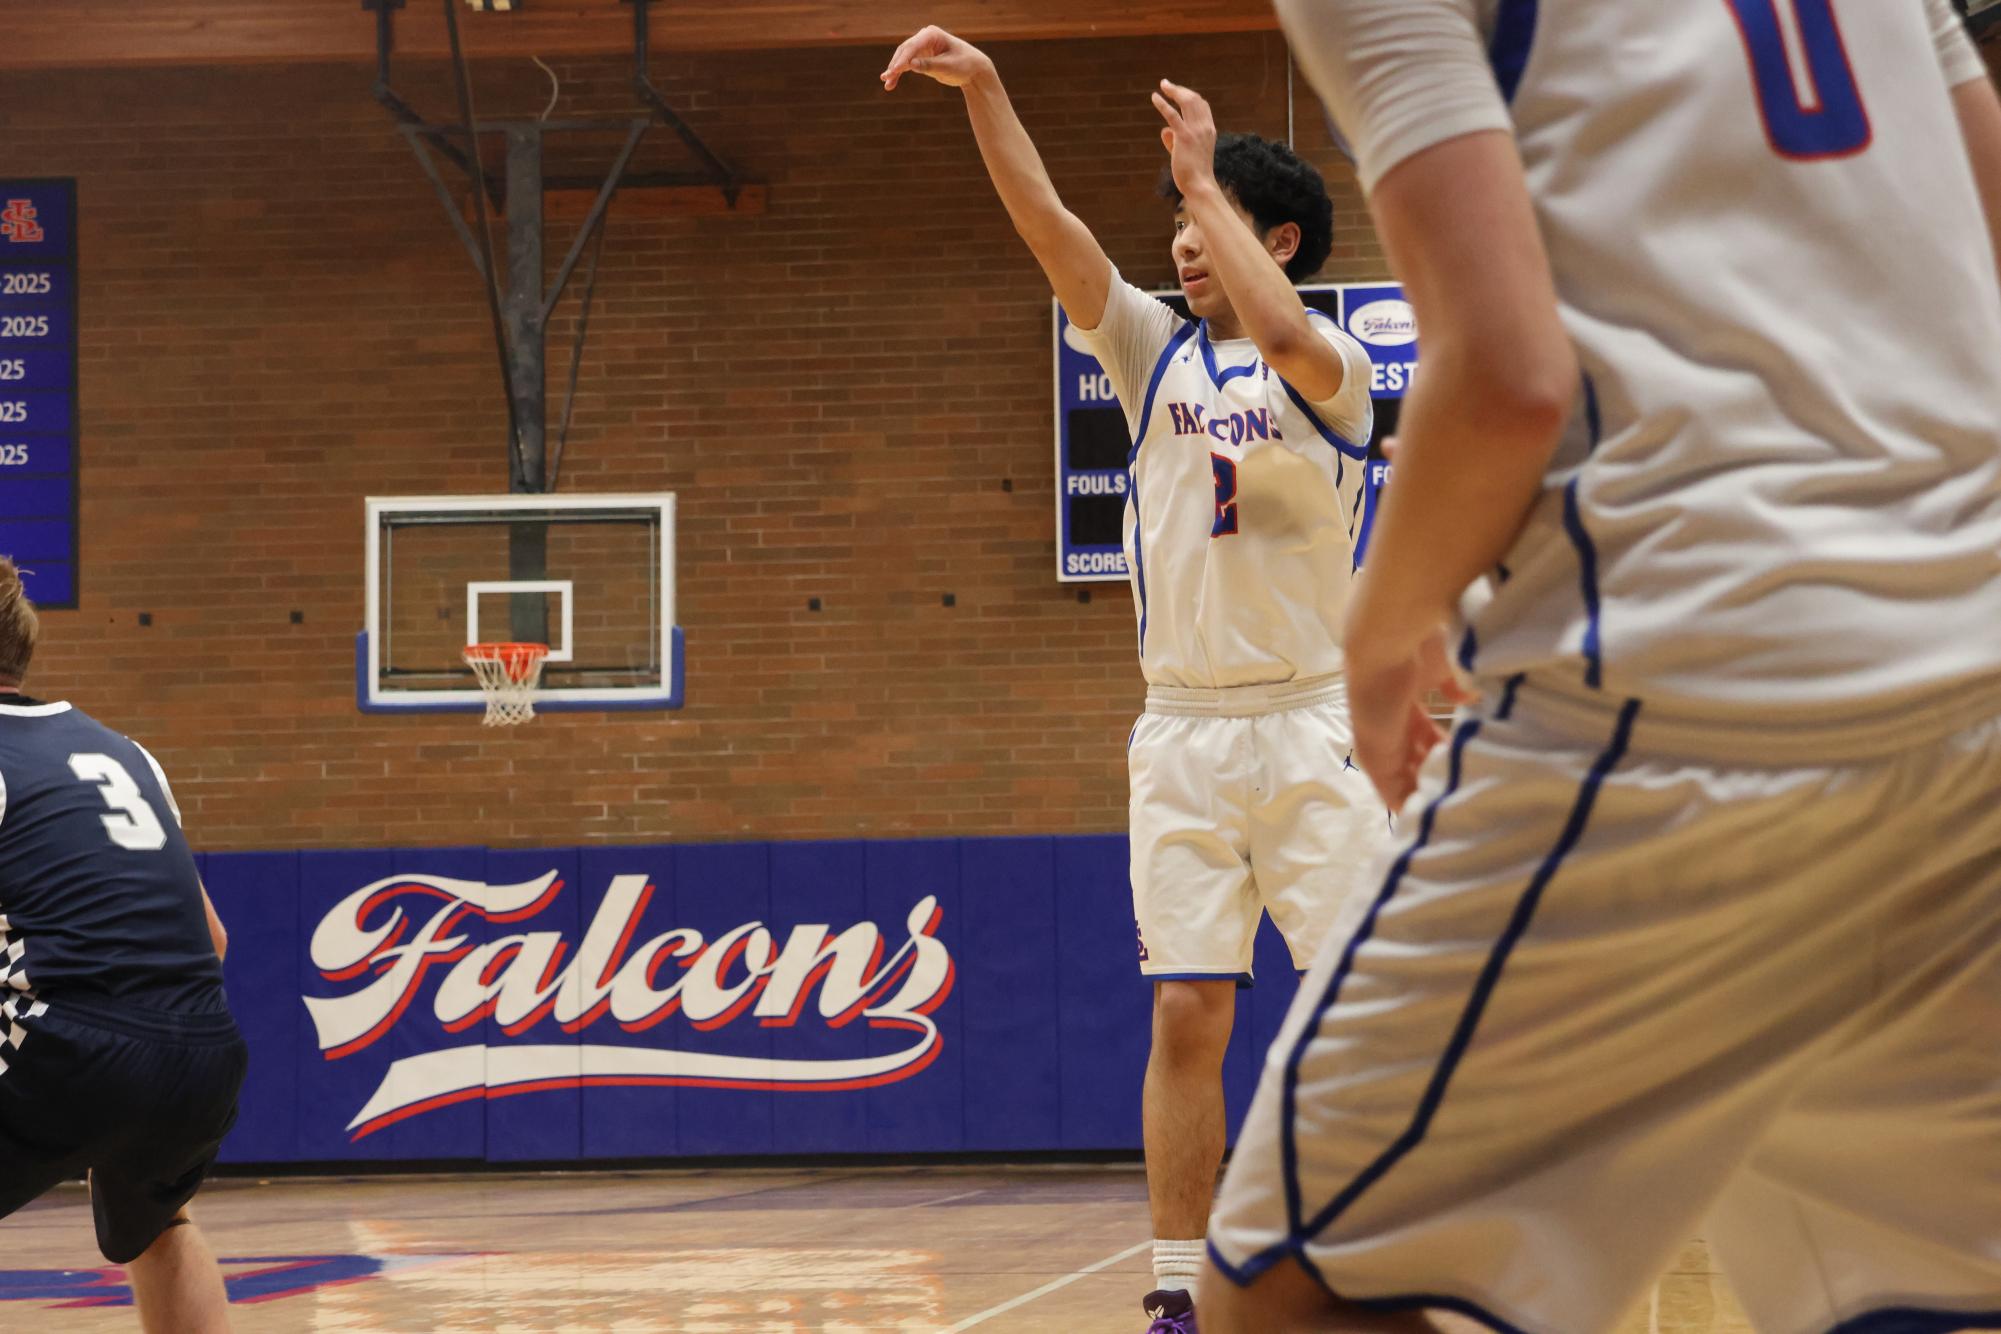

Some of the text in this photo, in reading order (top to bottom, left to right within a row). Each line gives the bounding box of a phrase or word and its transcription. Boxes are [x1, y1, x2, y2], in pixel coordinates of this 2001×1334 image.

[3, 273, 51, 294] 2025
[0, 316, 49, 337] 2025
[0, 359, 25, 380] 25
[1371, 362, 1418, 391] EST
[1078, 373, 1115, 401] HO
[0, 402, 27, 422] 25
[0, 444, 29, 465] 25
[1067, 474, 1127, 495] FOULS
[1210, 451, 1238, 538] 2
[1067, 552, 1128, 573] SCORE
[67, 753, 167, 850] 3
[302, 869, 955, 1142] Falcons
